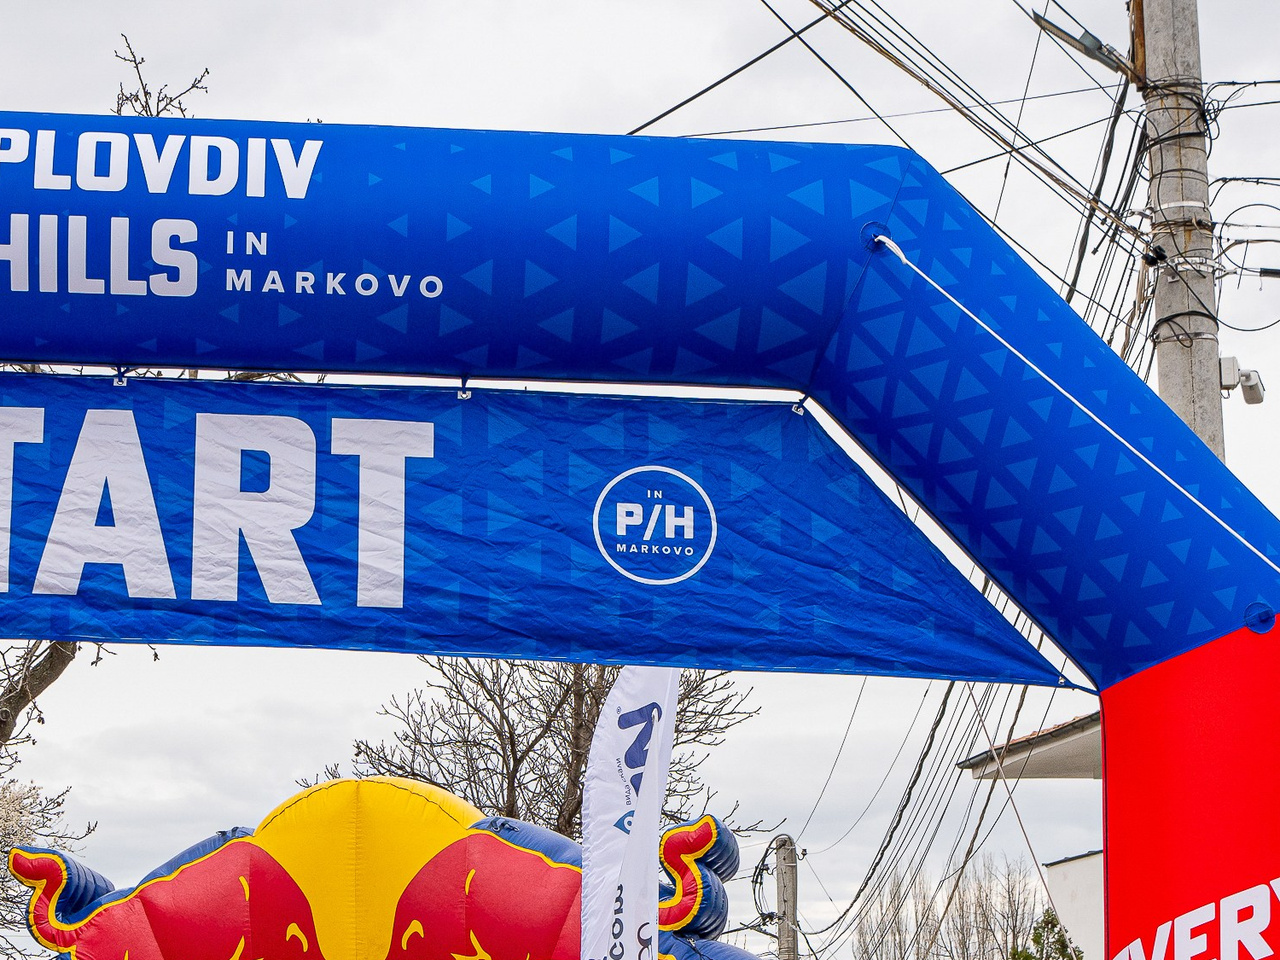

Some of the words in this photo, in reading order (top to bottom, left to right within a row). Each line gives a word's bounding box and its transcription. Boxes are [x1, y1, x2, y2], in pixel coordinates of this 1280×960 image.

[226, 230, 268, 257] IN
[226, 268, 444, 299] MARKOVO
[646, 489, 663, 499] IN
[616, 502, 694, 541] P/H
[616, 543, 694, 556] MARKOVO
